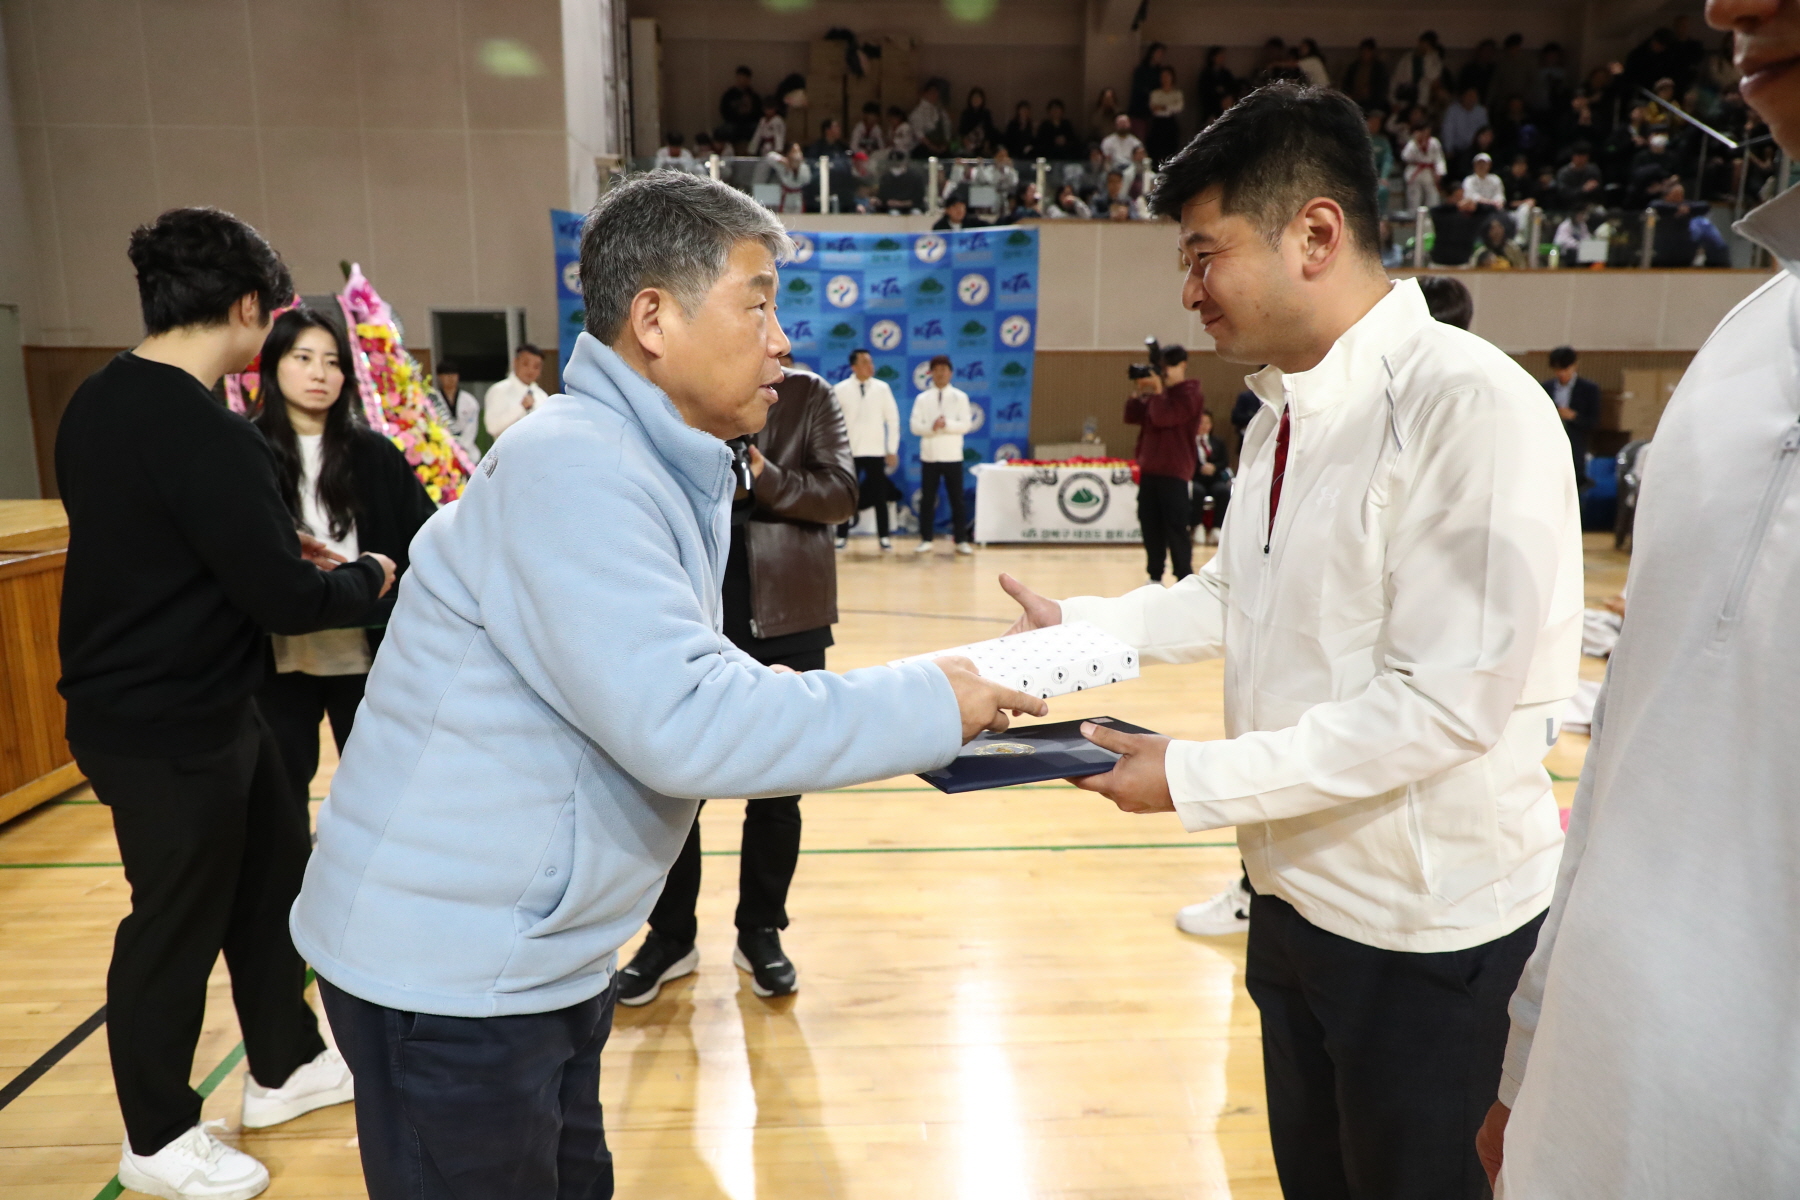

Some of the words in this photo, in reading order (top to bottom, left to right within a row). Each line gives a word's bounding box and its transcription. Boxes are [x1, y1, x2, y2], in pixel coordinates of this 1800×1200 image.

[870, 276, 902, 297] KTA
[1001, 272, 1031, 293] KTA
[913, 319, 943, 339] KTA
[956, 361, 985, 380] KTA
[996, 401, 1023, 421] KTA
